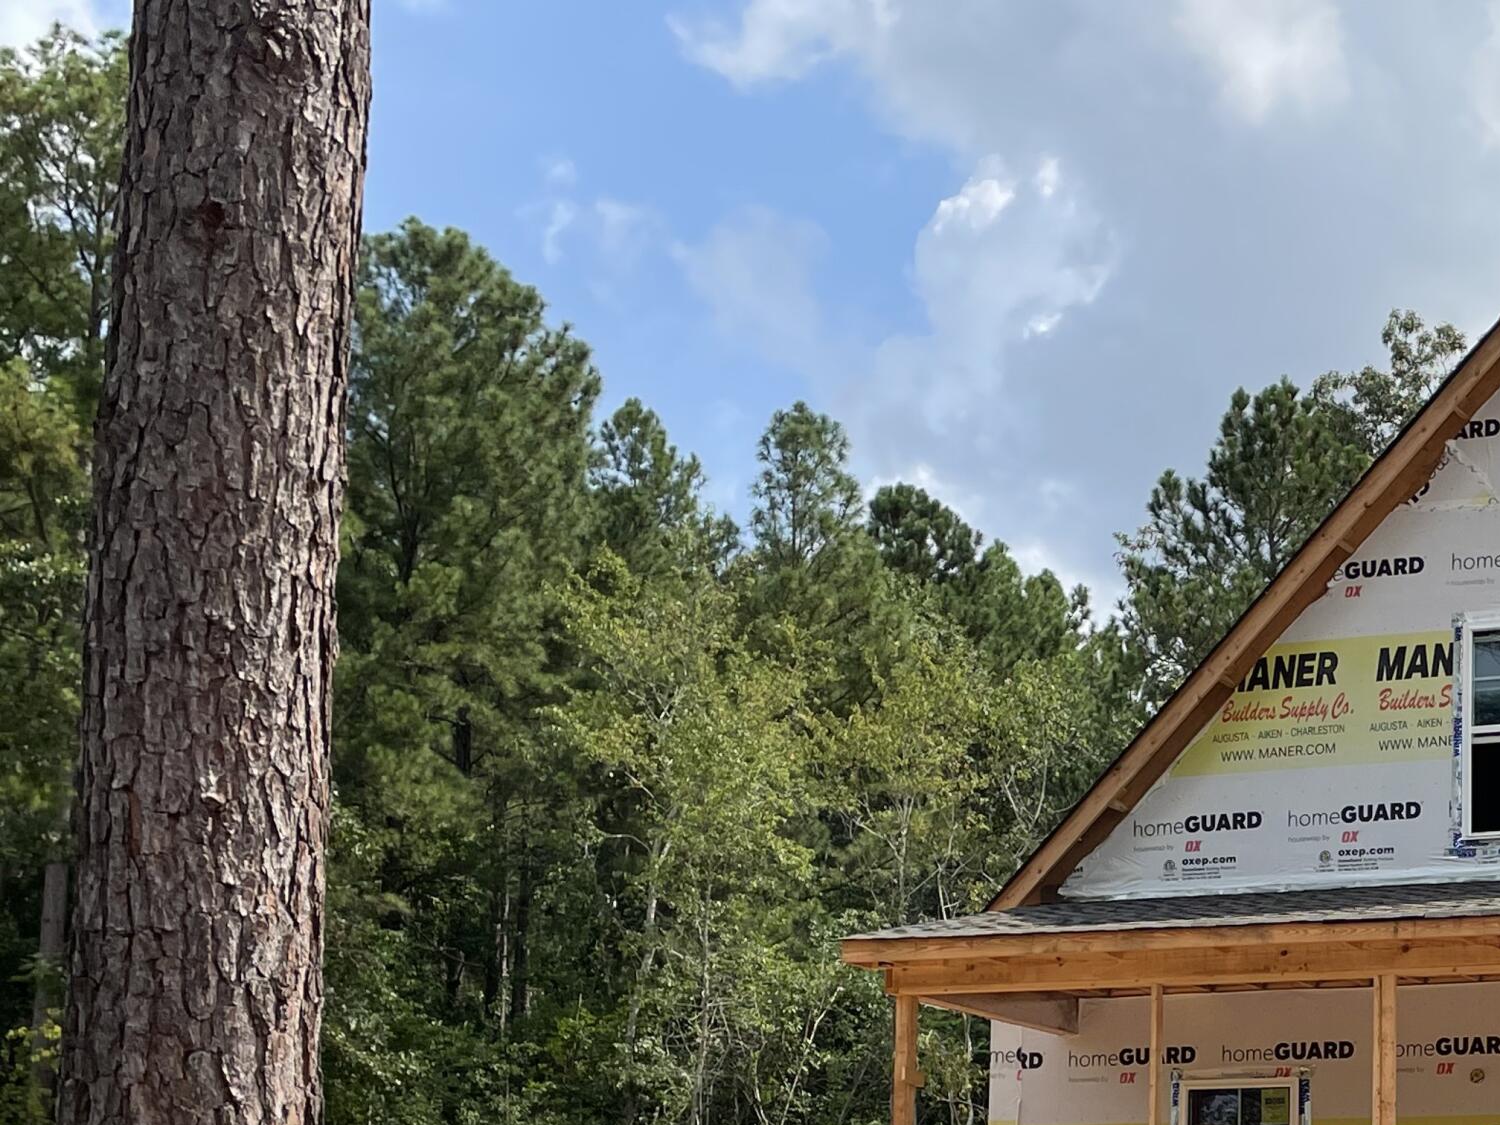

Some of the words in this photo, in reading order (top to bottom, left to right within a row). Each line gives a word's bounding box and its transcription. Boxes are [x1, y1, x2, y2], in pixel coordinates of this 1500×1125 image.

[1333, 556, 1425, 582] eGUARD
[1344, 585, 1363, 598] OX
[1376, 642, 1454, 682] MAN
[1222, 699, 1276, 724] Builders
[1279, 695, 1329, 723] Supply
[1331, 691, 1354, 720] Co.
[1378, 687, 1436, 712] Builders
[1212, 732, 1249, 744] AUGUSTA
[1258, 728, 1283, 740] AIKEN
[1291, 723, 1345, 738] CHARLESTON
[1369, 720, 1408, 733] AUGUSTA
[1416, 717, 1443, 729] AIKEN
[1258, 743, 1336, 760] MANER.COM
[1133, 811, 1262, 838] homeGUARD
[1288, 801, 1422, 829] homeGUARD
[1184, 840, 1202, 853] OX
[1341, 830, 1360, 844] OX
[1182, 855, 1236, 866] oxep.com
[1338, 846, 1394, 858] oxep.com
[1068, 1046, 1196, 1068] homeGURD
[1221, 1040, 1355, 1063] homeGUARD
[1120, 1072, 1136, 1084] OX
[1436, 1062, 1455, 1075] OX
